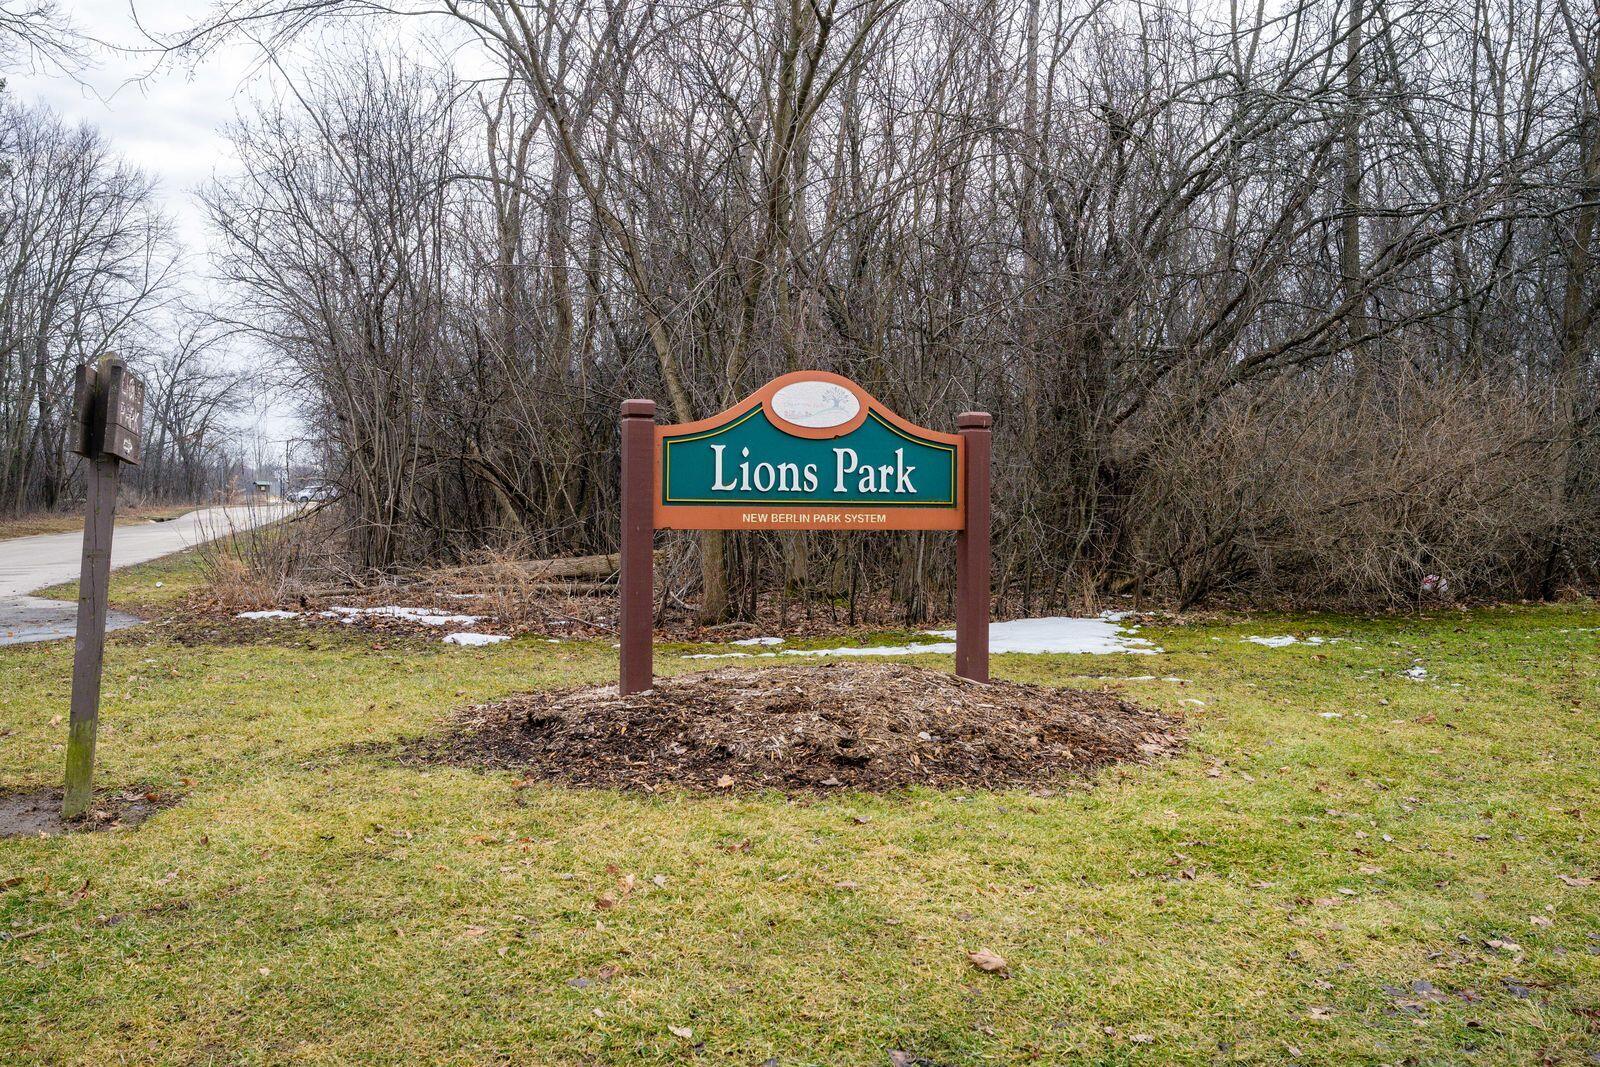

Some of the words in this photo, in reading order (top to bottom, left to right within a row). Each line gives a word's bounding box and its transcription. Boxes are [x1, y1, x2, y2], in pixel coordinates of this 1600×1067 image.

[710, 444, 819, 493] Lions
[832, 447, 918, 494] Park
[742, 513, 768, 523] NEW
[771, 513, 810, 523] BERLIN
[813, 513, 842, 523] PARK
[844, 513, 887, 523] SYSTEM
